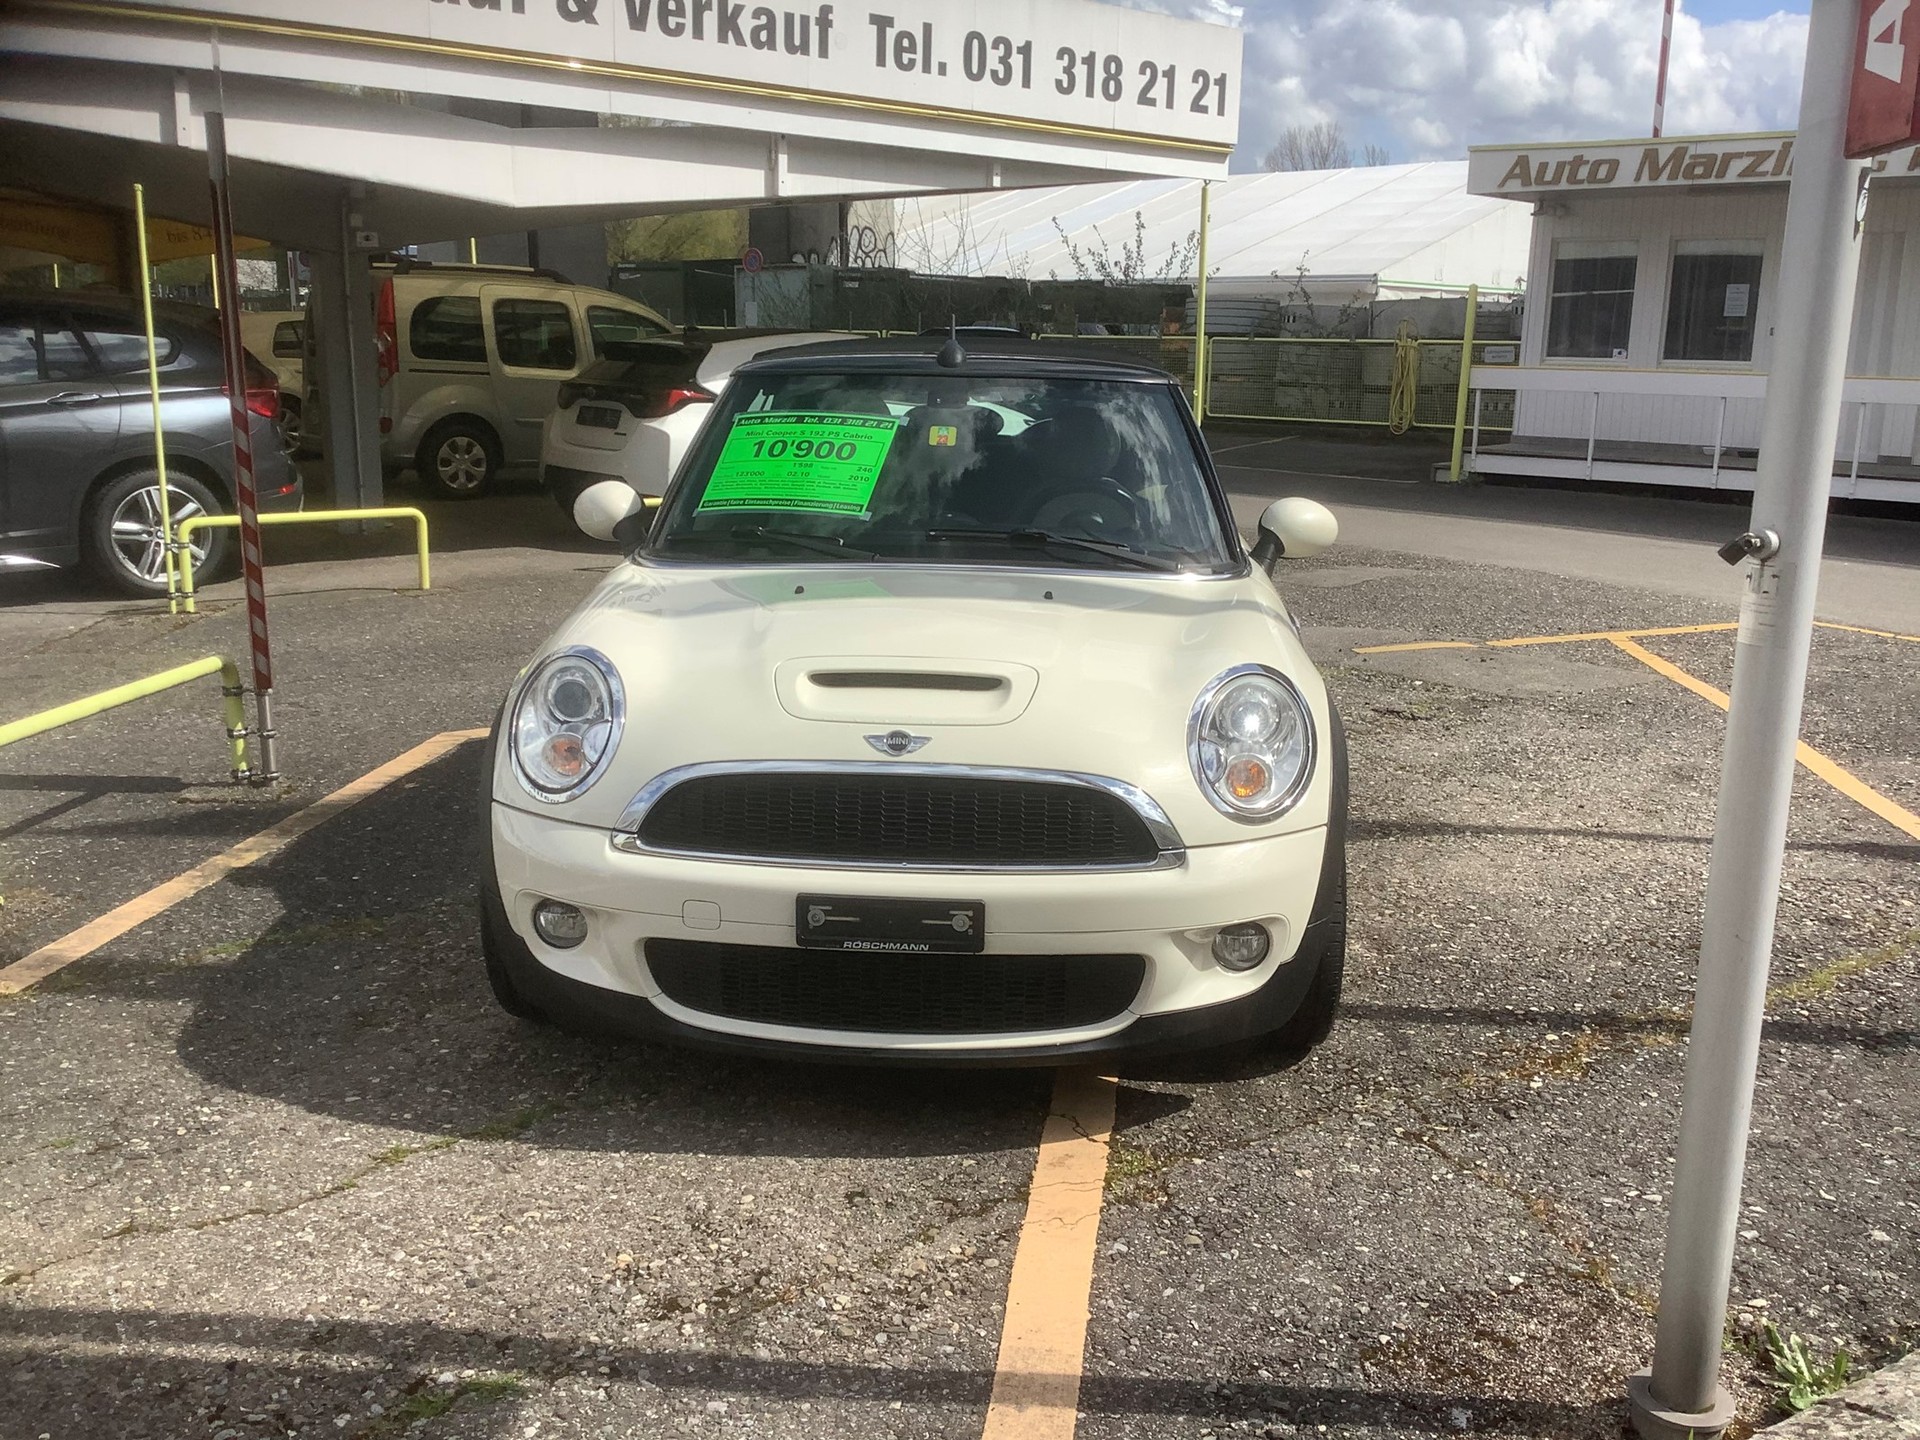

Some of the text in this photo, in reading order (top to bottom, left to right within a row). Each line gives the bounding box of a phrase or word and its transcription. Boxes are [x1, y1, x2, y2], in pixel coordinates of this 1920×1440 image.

[868, 13, 947, 77] Tel.
[963, 30, 1033, 90] 031
[1054, 46, 1124, 103] 318
[1137, 60, 1176, 110] 21
[1190, 69, 1228, 117] 21
[1497, 154, 1620, 188] Auto
[738, 417, 761, 426] Auto
[802, 416, 820, 424] Tel.
[823, 417, 842, 425] 031
[843, 418, 863, 427] 318
[865, 420, 878, 428] 21
[879, 421, 893, 430] 21
[766, 429, 798, 439] Cooper
[842, 431, 874, 440] Cabrio
[752, 439, 858, 461] 10'900
[848, 475, 870, 483] 2010
[886, 737, 909, 746] MINI
[842, 940, 930, 952] RÖSCHMANN
